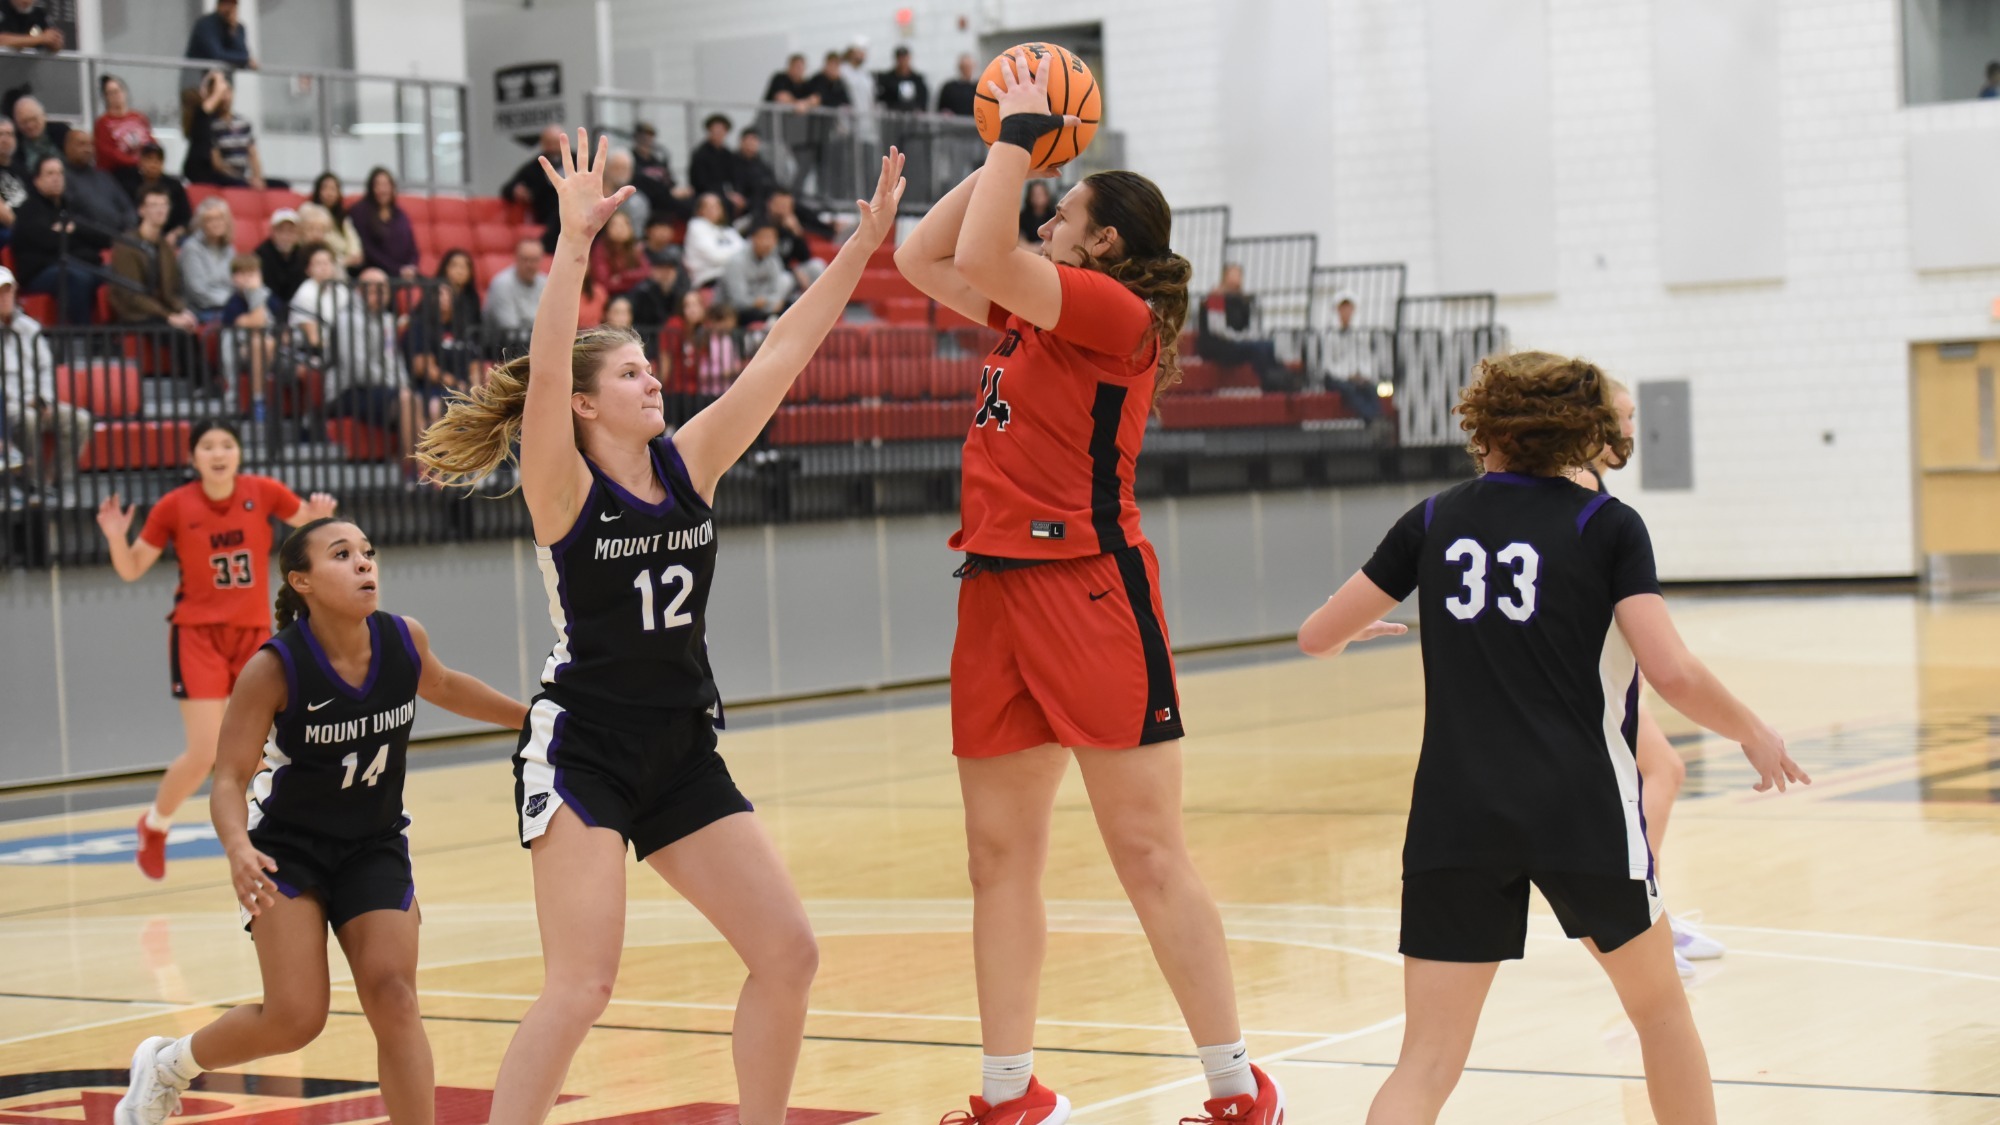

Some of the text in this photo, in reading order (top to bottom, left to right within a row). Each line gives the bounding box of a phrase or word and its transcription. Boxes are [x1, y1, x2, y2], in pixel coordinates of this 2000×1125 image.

[594, 517, 713, 560] MOUNT UNION
[1053, 526, 1060, 535] L
[208, 549, 255, 590] 33
[1445, 538, 1539, 623] 33
[632, 564, 694, 631] 12
[305, 698, 414, 744] MOUNT UNION
[341, 743, 390, 790] 14
